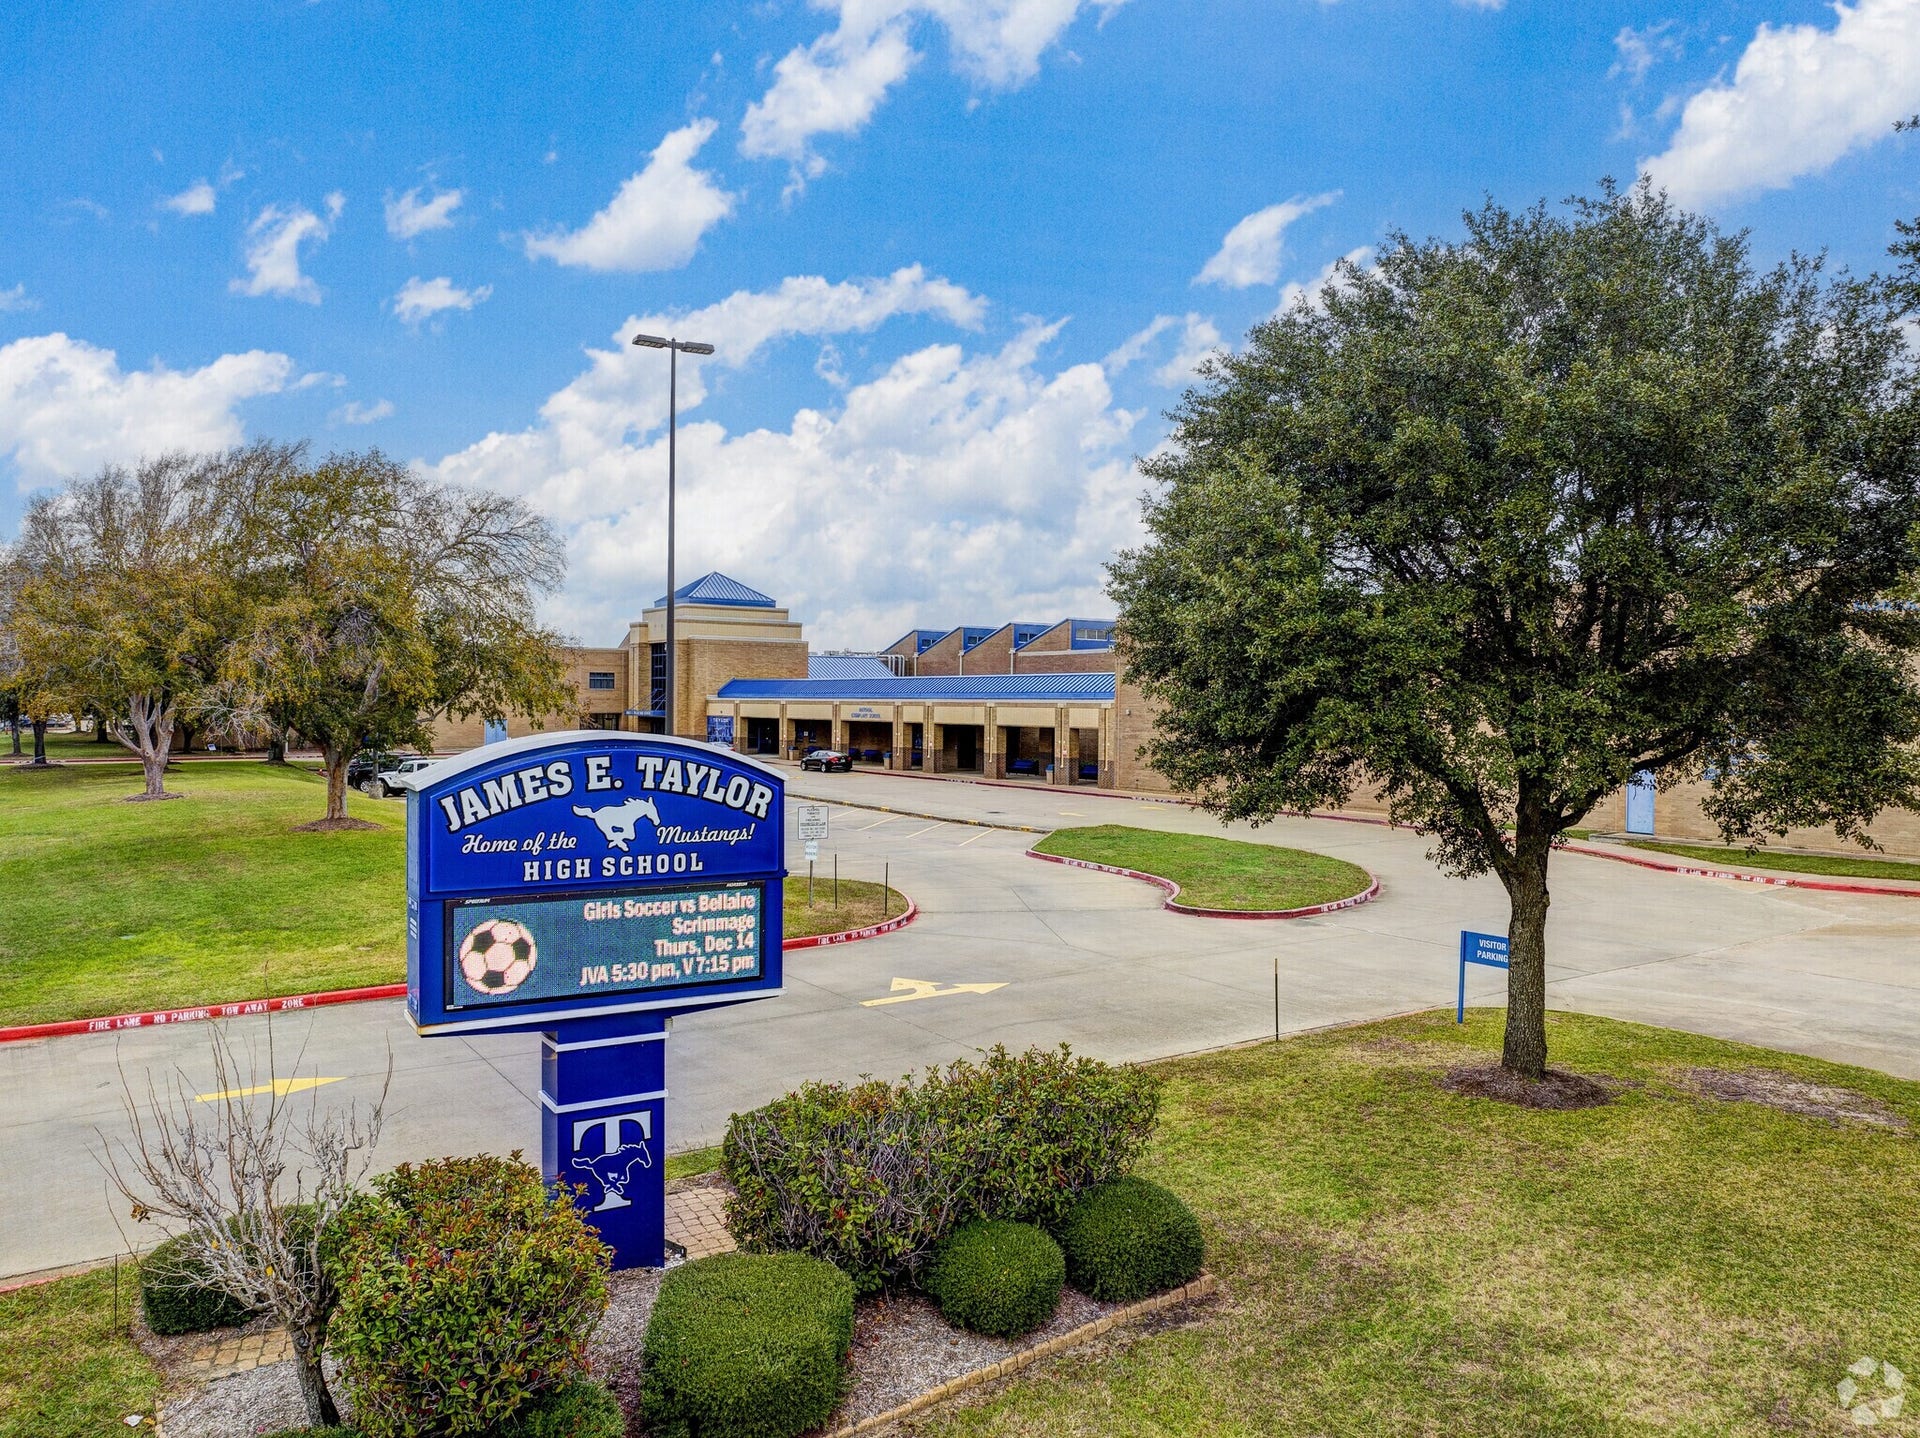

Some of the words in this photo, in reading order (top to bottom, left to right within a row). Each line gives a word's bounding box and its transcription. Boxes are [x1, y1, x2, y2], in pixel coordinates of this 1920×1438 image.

[440, 761, 573, 832] JAMES
[586, 756, 623, 790] E.
[637, 756, 773, 818] TAYLOR
[462, 834, 517, 854] Home
[521, 831, 546, 855] of
[547, 831, 577, 850] the
[656, 823, 756, 846] Mustangs!
[523, 858, 591, 881] HIGH
[602, 852, 703, 877] SCHOOL
[583, 900, 621, 921] Girls
[623, 899, 678, 919] Soccer
[680, 899, 696, 914] vs
[698, 893, 756, 913] Bellaire
[672, 914, 756, 935] Scrimmage
[654, 938, 702, 956] Thurs,
[704, 934, 733, 953] Dec
[736, 931, 755, 950] 14
[1476, 950, 1508, 963] PARKING
[1478, 938, 1507, 951] VISITOR
[579, 965, 609, 987] JVA
[610, 961, 649, 983] 5:30
[650, 962, 681, 982] pm,
[682, 958, 694, 975] V
[695, 954, 730, 974] 7:15
[731, 955, 754, 975] pm
[88, 1020, 111, 1031] FIRE
[117, 1016, 141, 1028] LANE
[153, 1014, 166, 1025] NO
[171, 1009, 210, 1022] PARKING
[221, 1005, 239, 1016] TOW
[244, 1002, 269, 1014] AWAY
[281, 998, 305, 1009] ZONE
